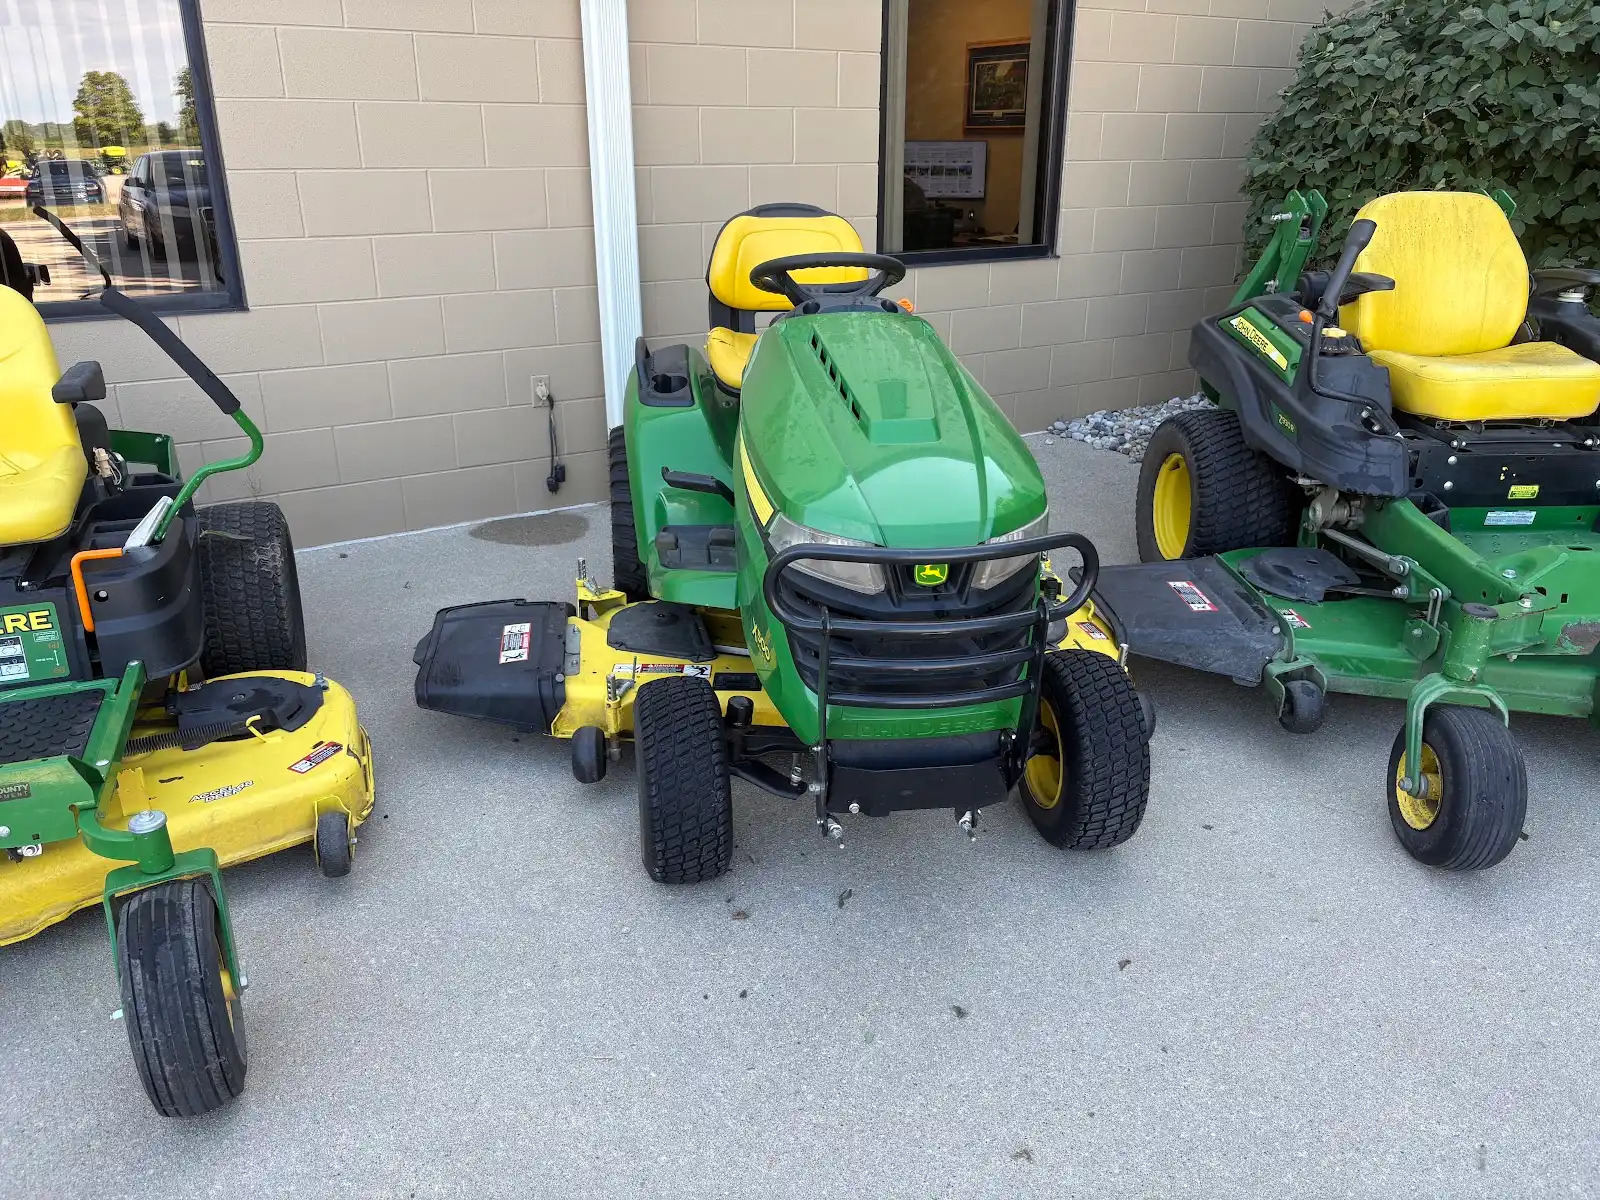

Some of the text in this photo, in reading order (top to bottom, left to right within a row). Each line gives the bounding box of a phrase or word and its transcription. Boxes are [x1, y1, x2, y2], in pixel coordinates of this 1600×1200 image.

[1235, 318, 1269, 352] JOHN DEERE
[0, 609, 53, 635] RE
[842, 716, 997, 738] JOHN DEERE
